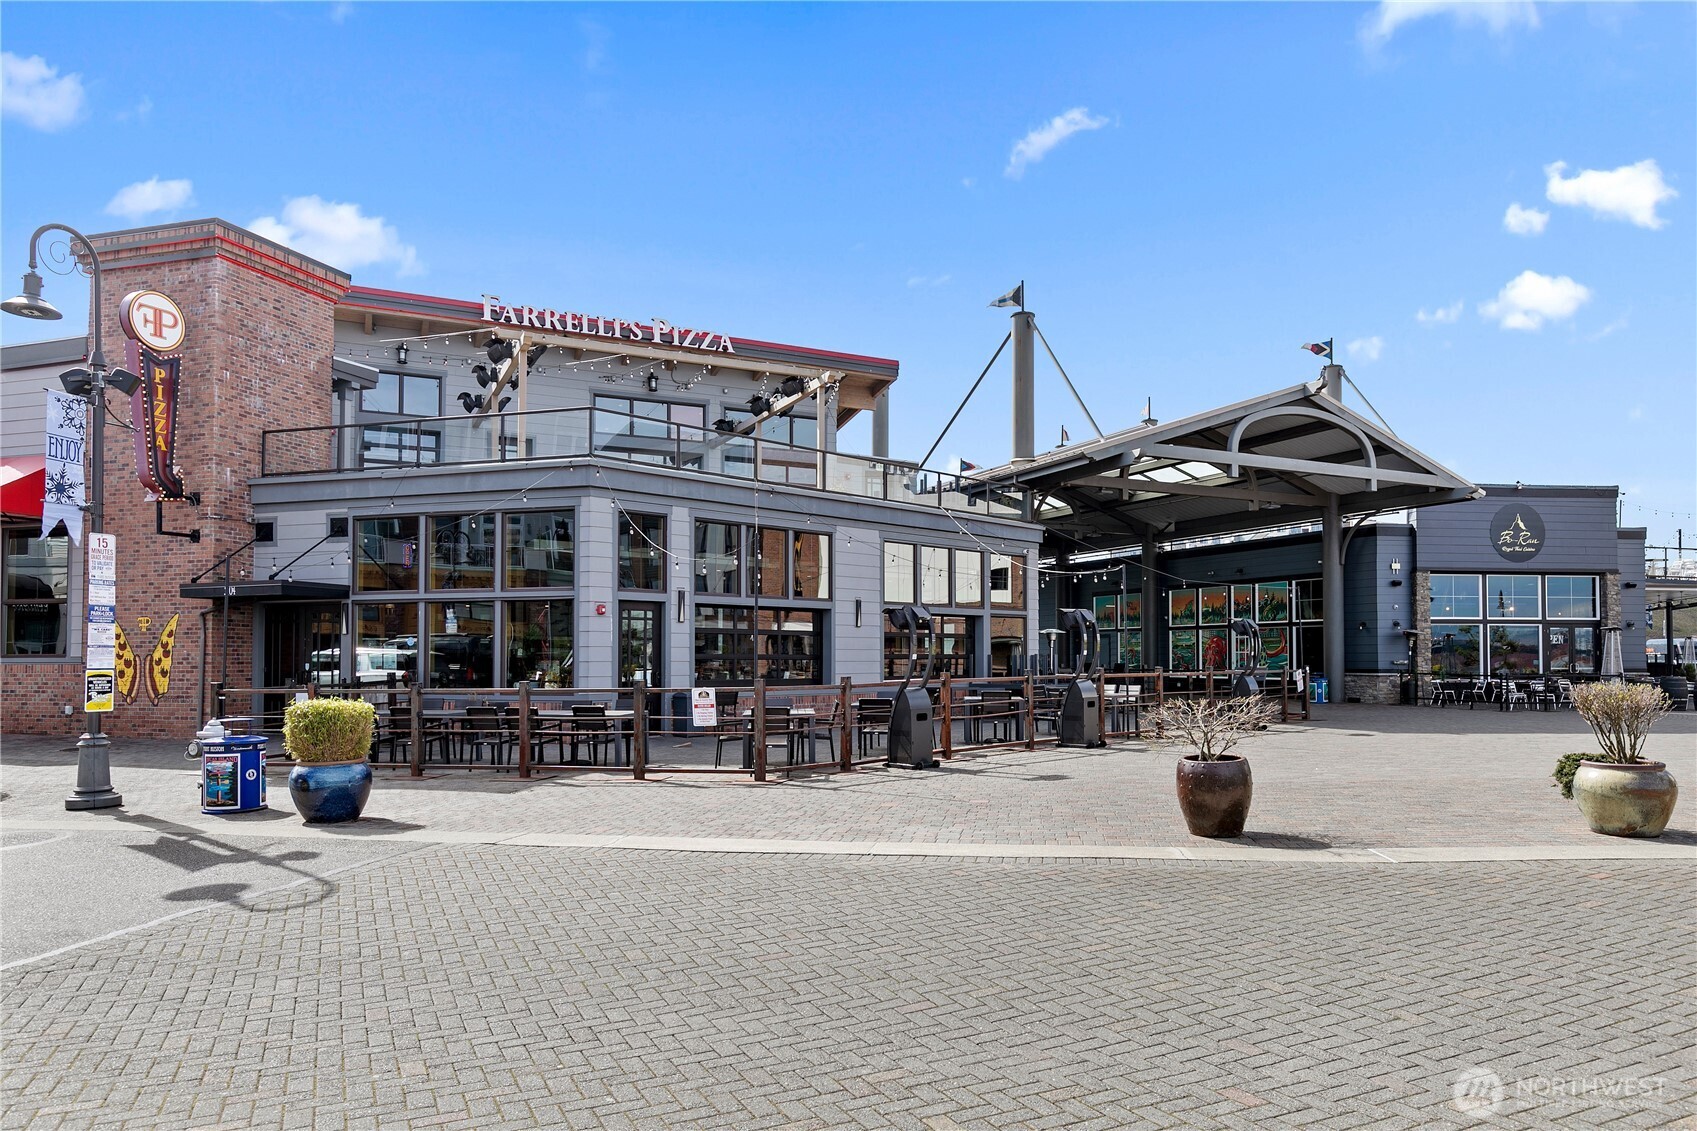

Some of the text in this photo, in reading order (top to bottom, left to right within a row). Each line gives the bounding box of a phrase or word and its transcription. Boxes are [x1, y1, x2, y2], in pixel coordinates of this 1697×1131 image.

[651, 317, 735, 353] PIZZA
[153, 367, 168, 451] PIZZA
[48, 435, 83, 463] ENJOY
[91, 548, 114, 556] MINUTES
[97, 538, 108, 548] 15
